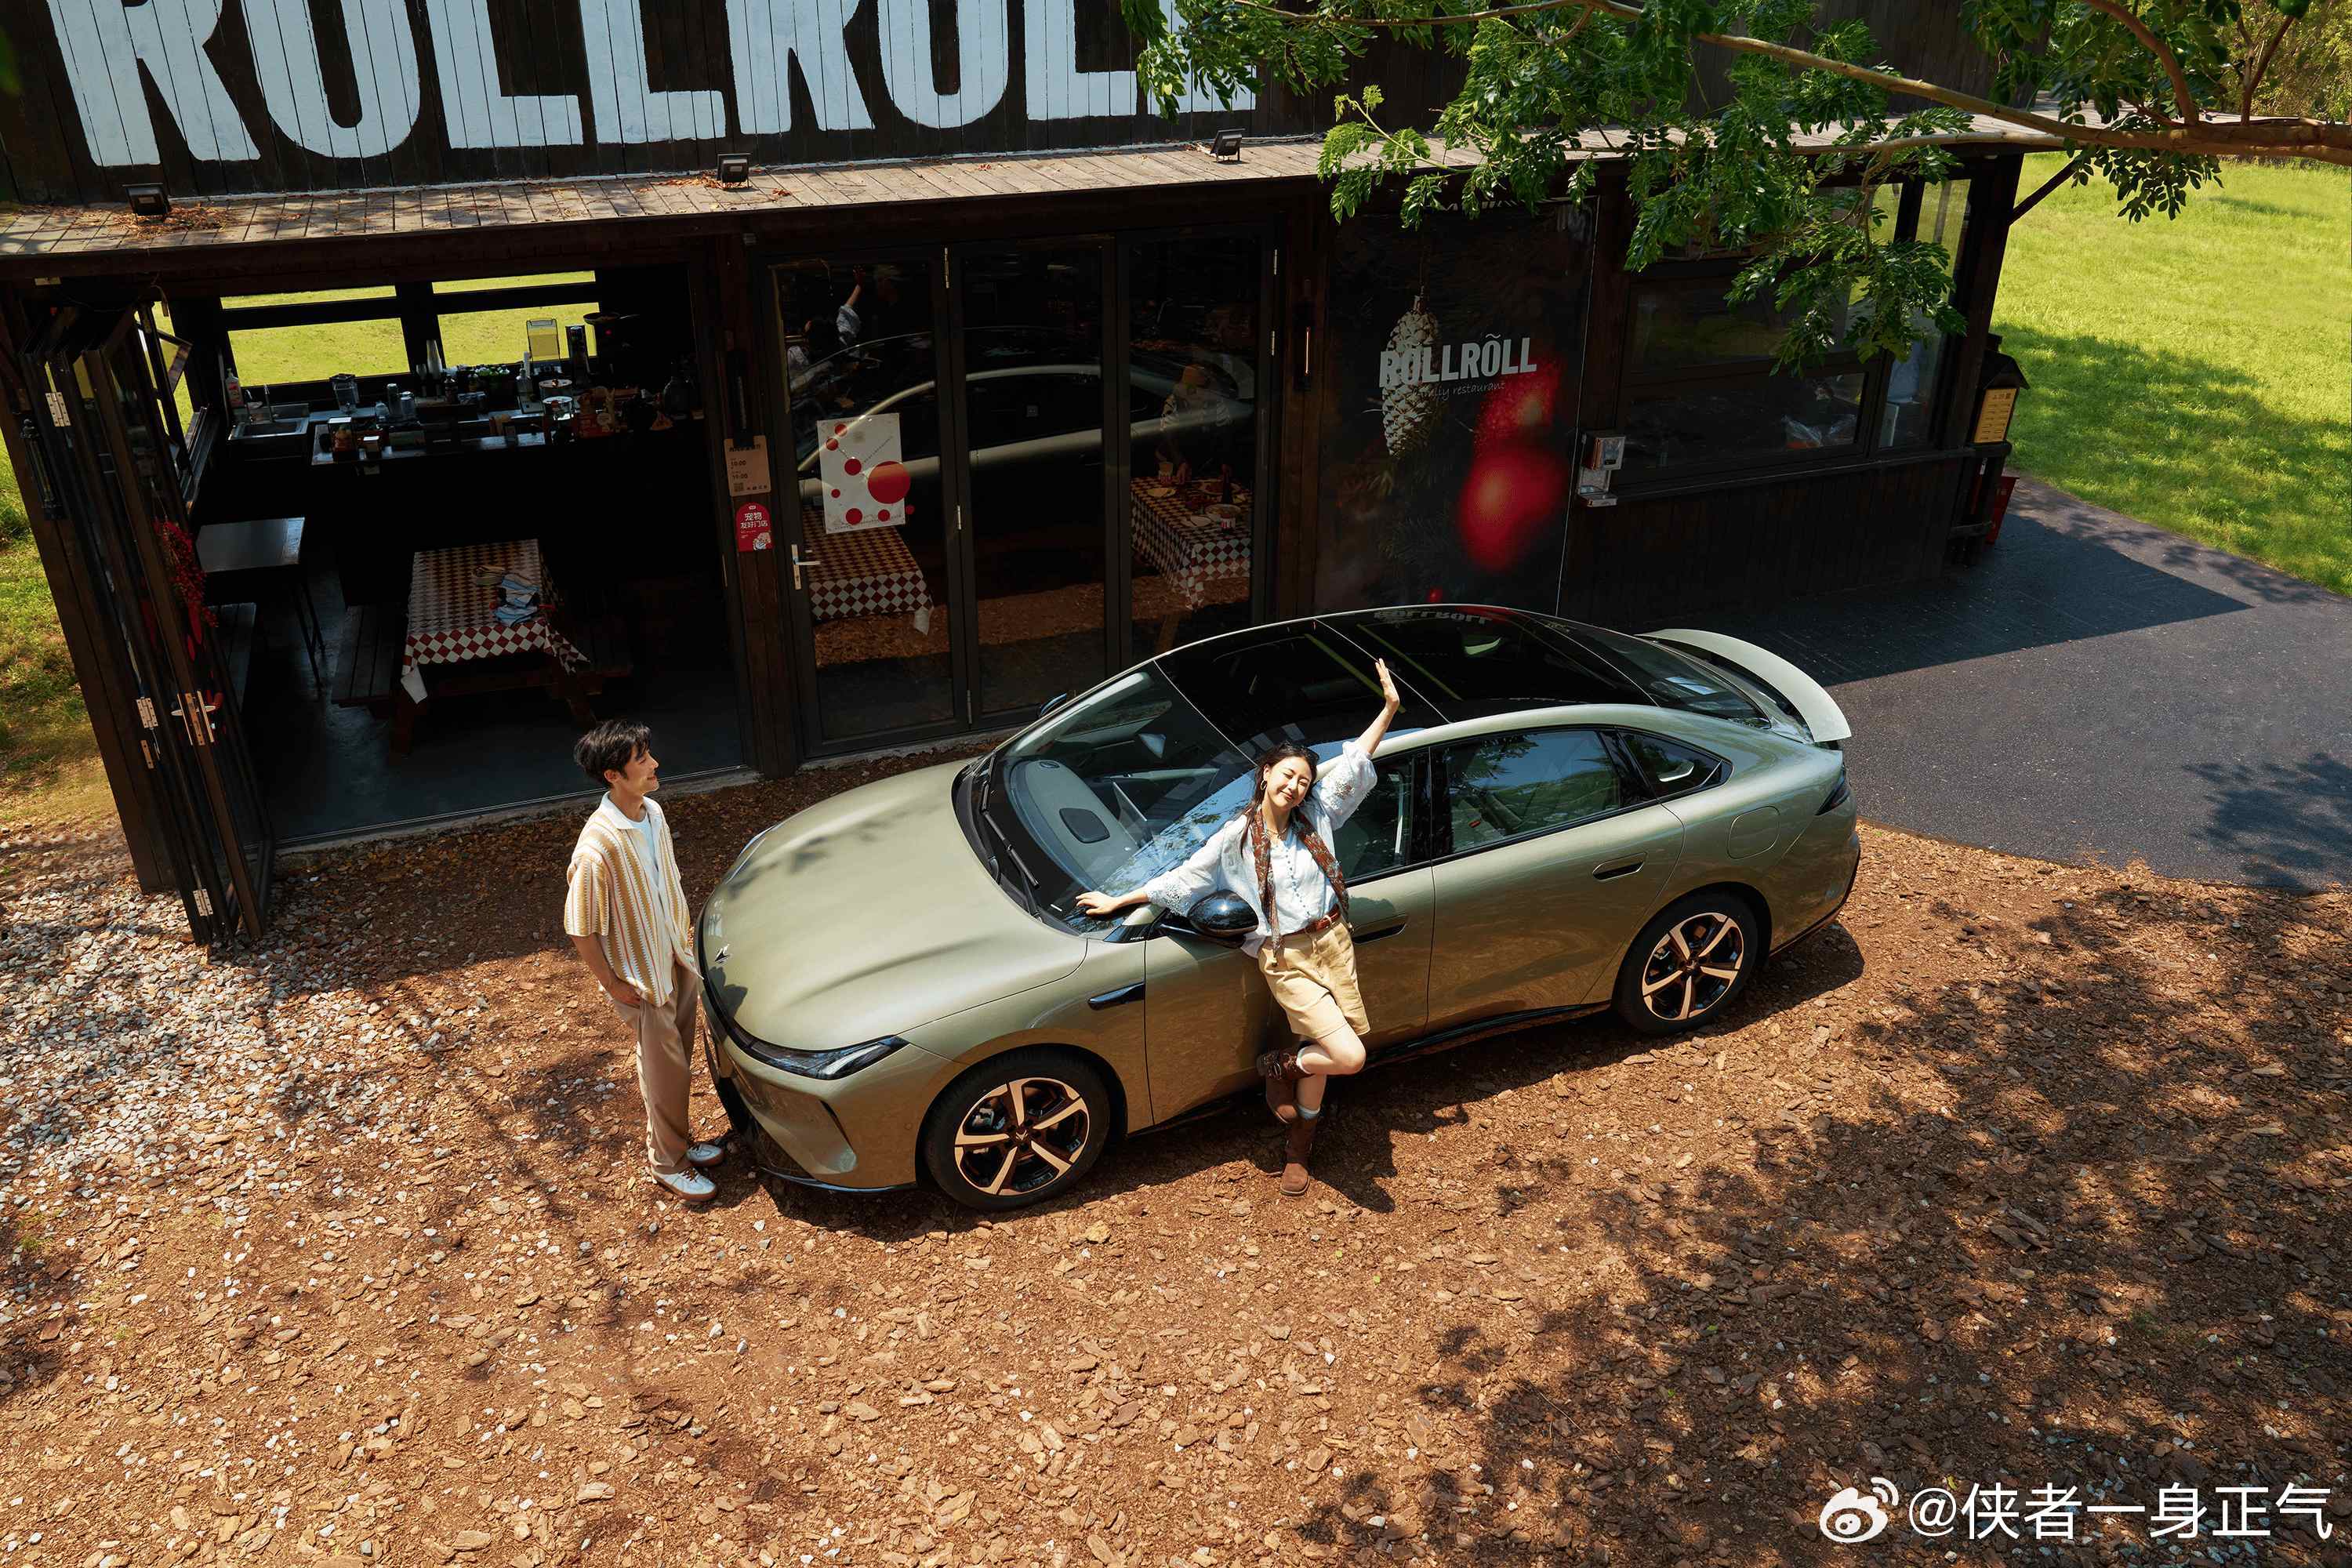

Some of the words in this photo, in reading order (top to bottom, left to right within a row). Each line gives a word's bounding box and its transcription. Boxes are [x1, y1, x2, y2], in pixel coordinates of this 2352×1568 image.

[1453, 382, 1506, 396] restaurant
[744, 511, 762, 521] 宠物
[740, 520, 768, 528] 友好门店
